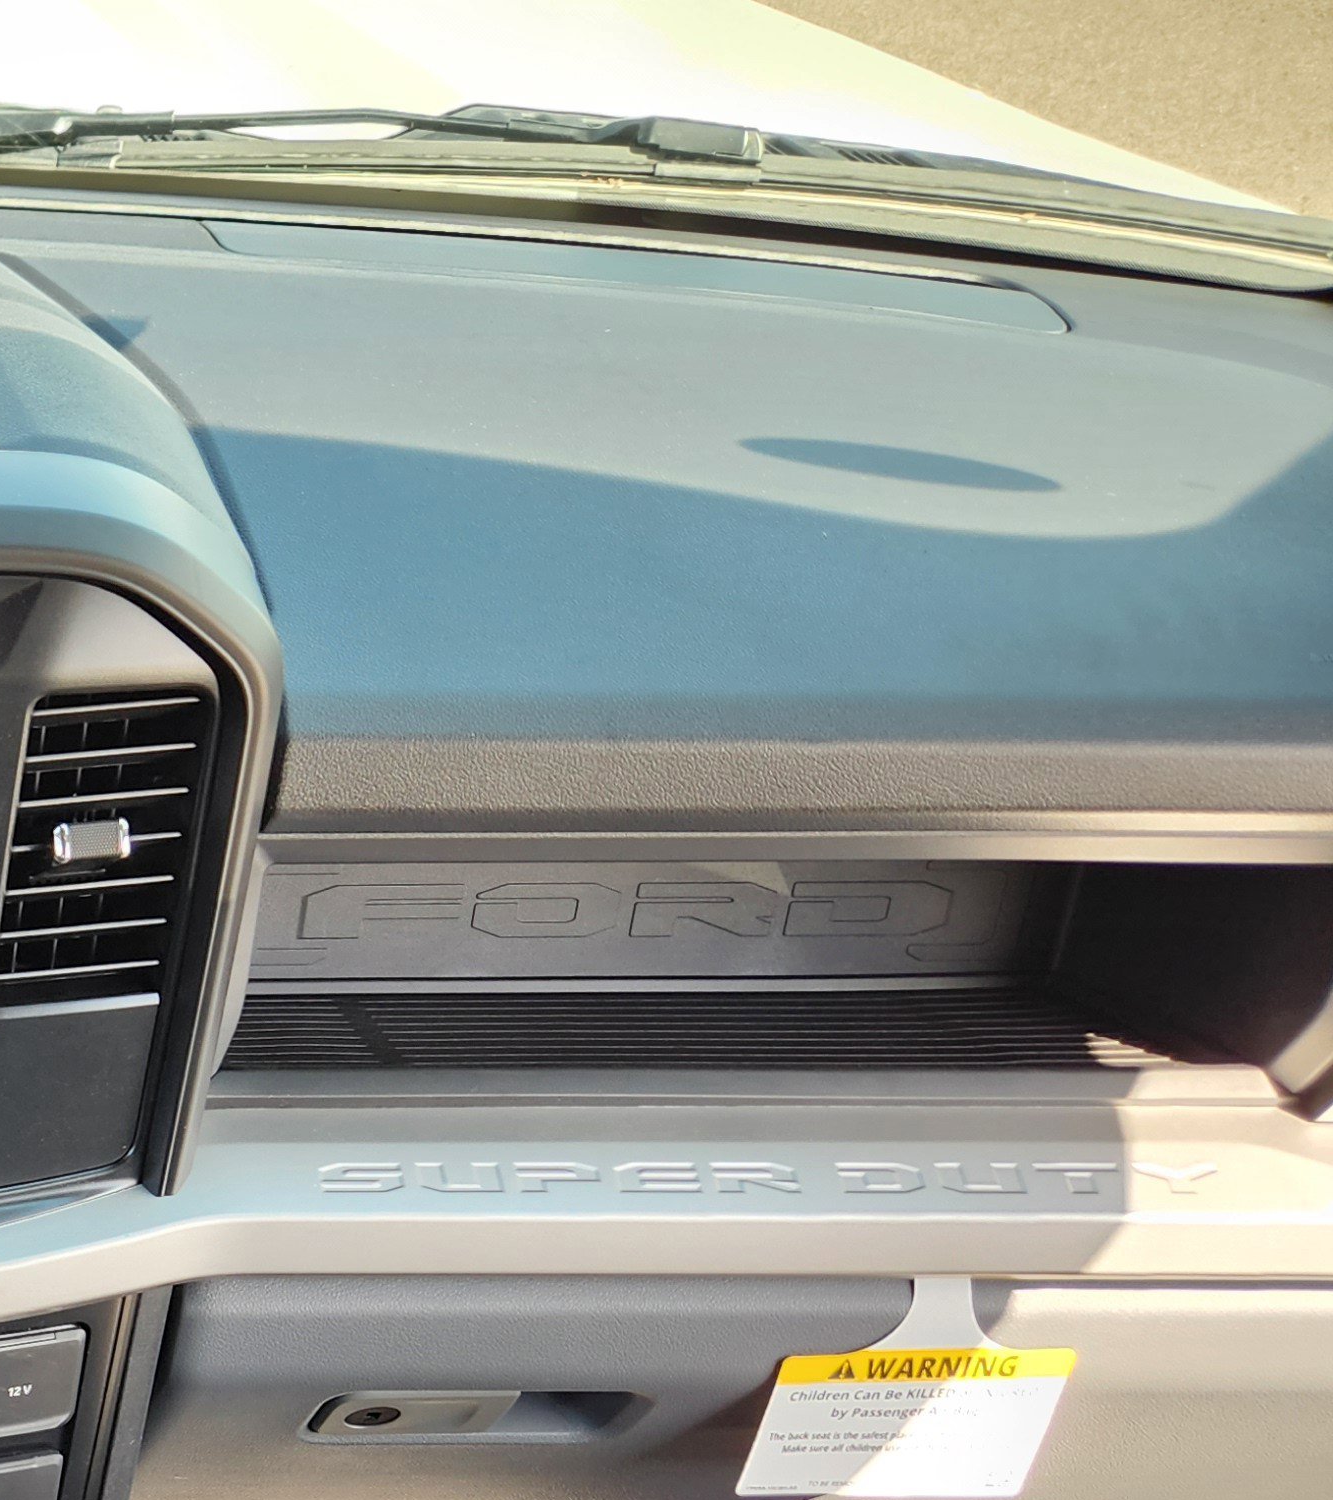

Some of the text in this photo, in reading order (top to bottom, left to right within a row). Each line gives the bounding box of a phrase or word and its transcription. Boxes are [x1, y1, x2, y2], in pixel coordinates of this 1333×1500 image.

[296, 880, 953, 940] FORD
[317, 1161, 1219, 1194] SUPER DUTY
[866, 1355, 1019, 1380] WARNING
[7, 1384, 32, 1397] 12 V
[789, 1390, 850, 1402] Children
[853, 1390, 880, 1401] Can
[884, 1389, 903, 1400] Be
[830, 1407, 849, 1421] by
[851, 1407, 925, 1420] Passenger
